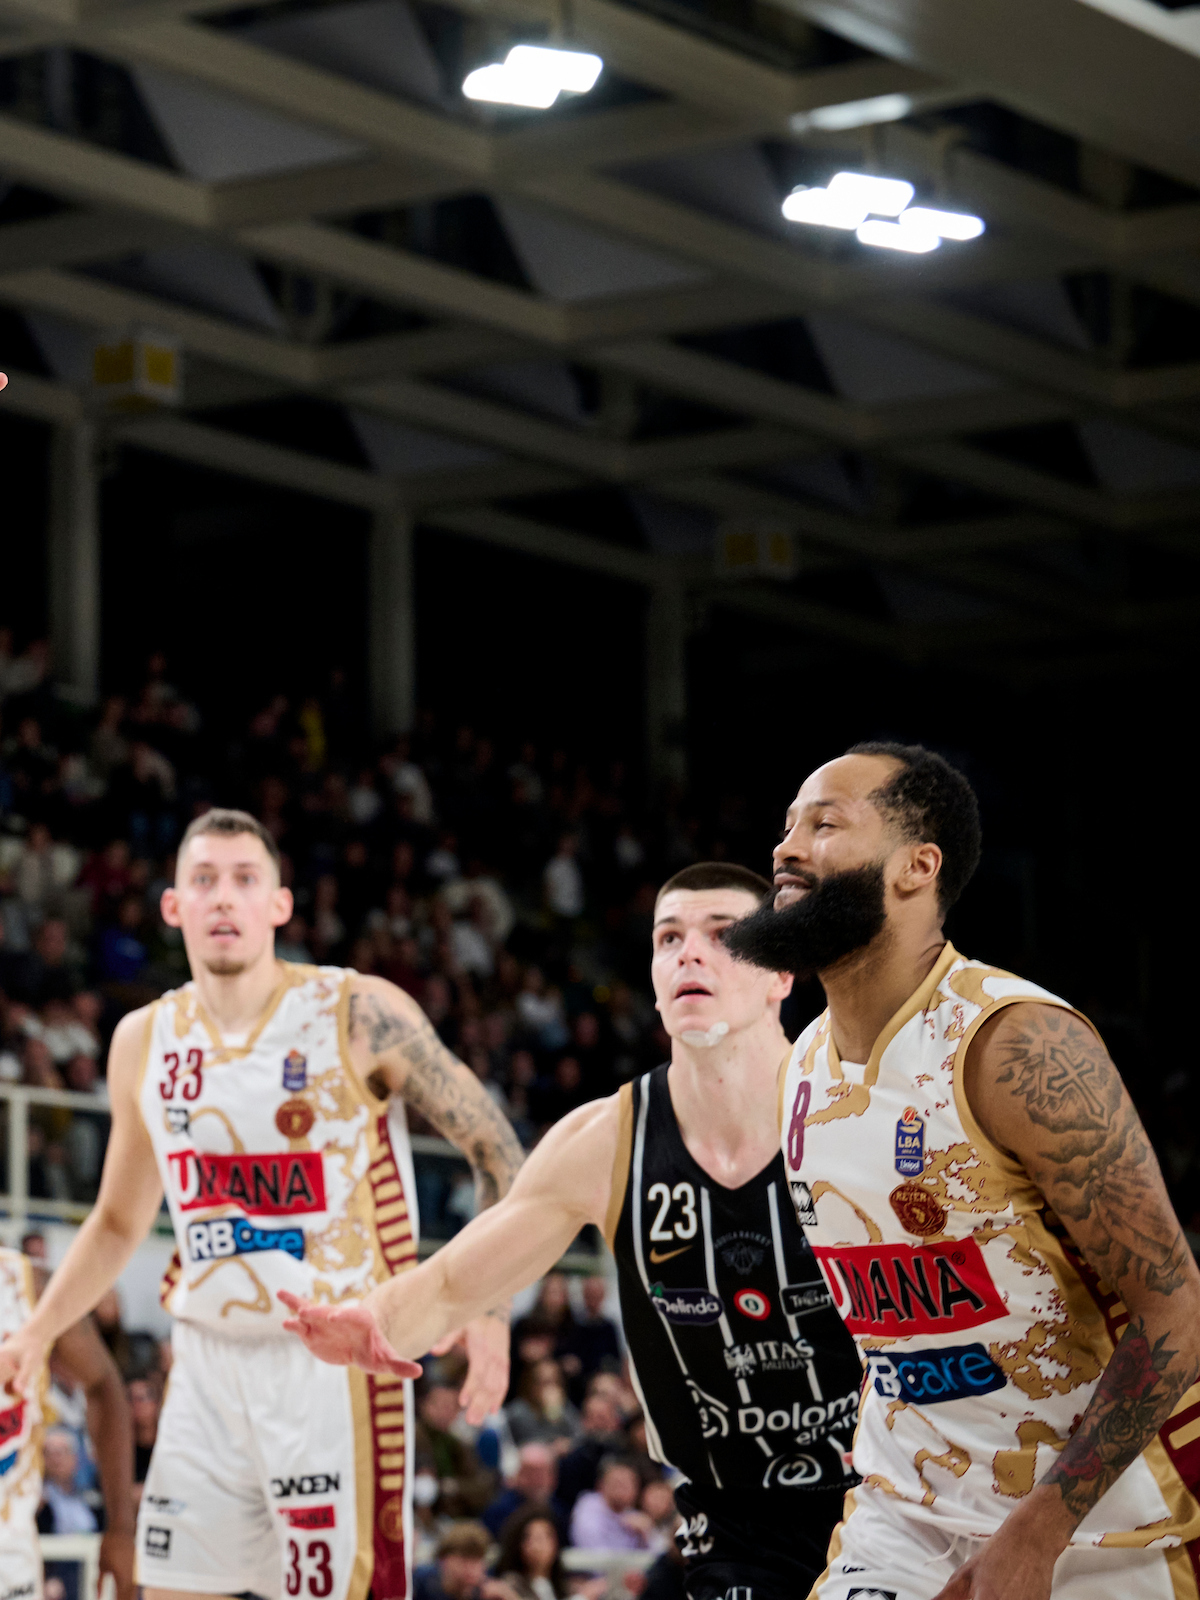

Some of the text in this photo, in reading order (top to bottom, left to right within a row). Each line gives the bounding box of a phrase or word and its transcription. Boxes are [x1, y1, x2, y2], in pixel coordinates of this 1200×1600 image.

[160, 1049, 203, 1100] 33
[788, 1081, 811, 1171] 8
[898, 1136, 921, 1149] LBA
[648, 1182, 697, 1241] 23
[816, 1256, 986, 1323] UMANA
[756, 1338, 815, 1361] ITAS
[286, 1539, 334, 1598] 33
